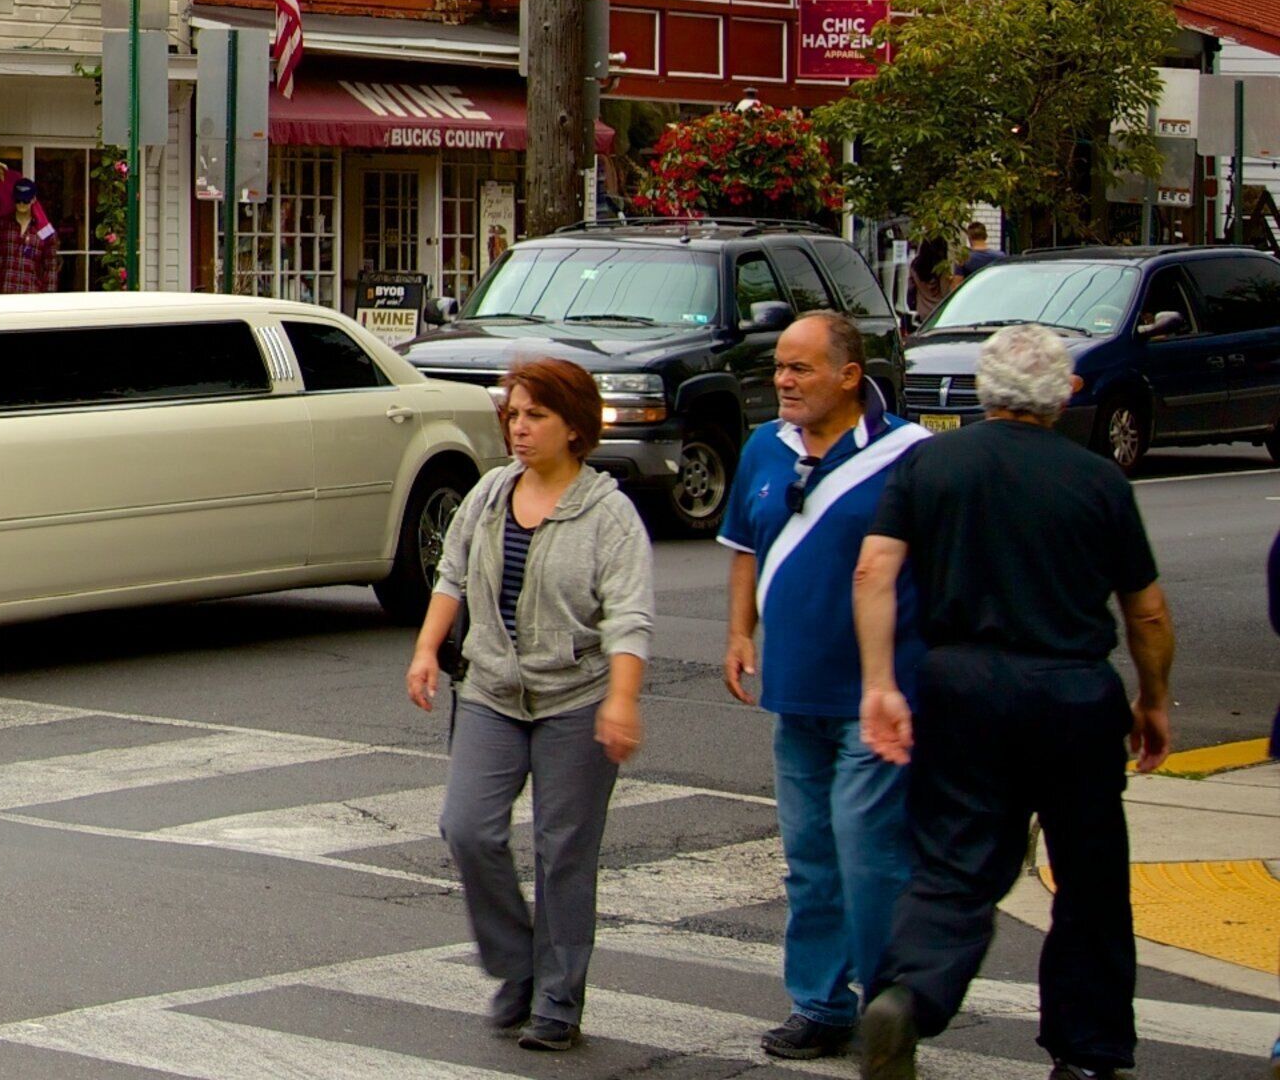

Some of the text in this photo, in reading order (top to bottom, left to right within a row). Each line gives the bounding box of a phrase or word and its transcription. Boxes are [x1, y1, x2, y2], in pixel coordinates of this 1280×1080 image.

[822, 17, 866, 34] CHIC
[338, 79, 493, 121] WINE
[391, 128, 441, 147] BUCKS
[445, 129, 505, 149] COUNTY
[375, 285, 405, 297] BYOB
[372, 311, 415, 326] WINE
